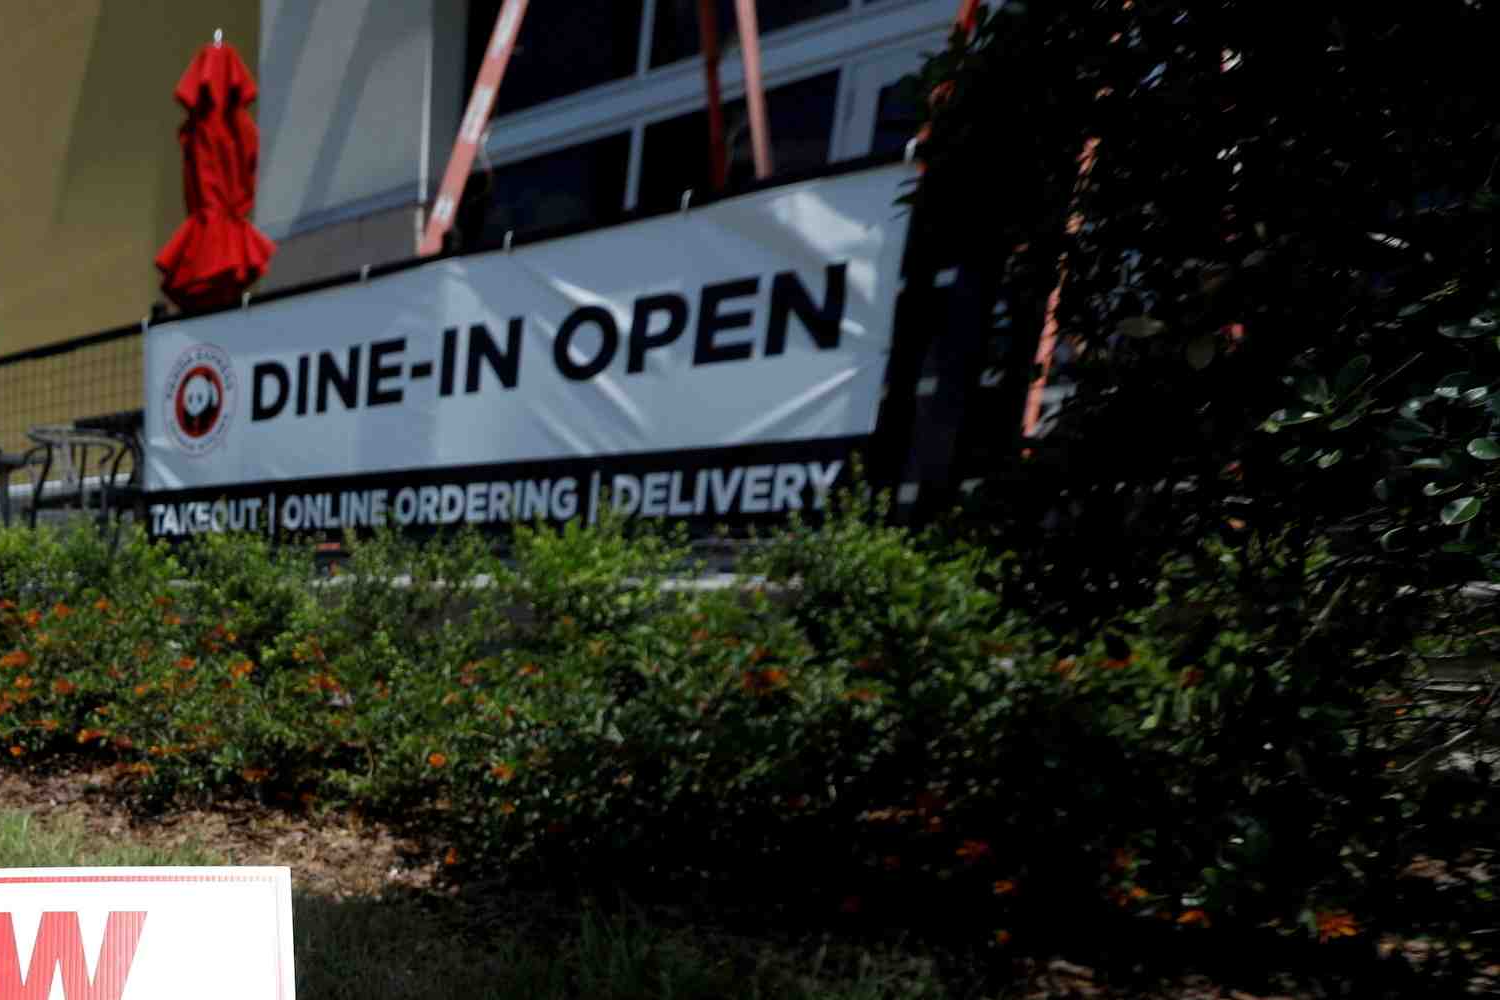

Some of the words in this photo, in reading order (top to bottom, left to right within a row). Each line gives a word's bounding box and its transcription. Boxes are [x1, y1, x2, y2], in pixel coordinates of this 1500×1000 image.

[251, 317, 524, 422] DINE-IN
[552, 263, 848, 382] OPEN
[151, 498, 260, 536] TAKEOUT
[283, 489, 387, 529] ONLINE
[396, 478, 577, 524] ORDERING
[613, 460, 842, 519] DELIVERY
